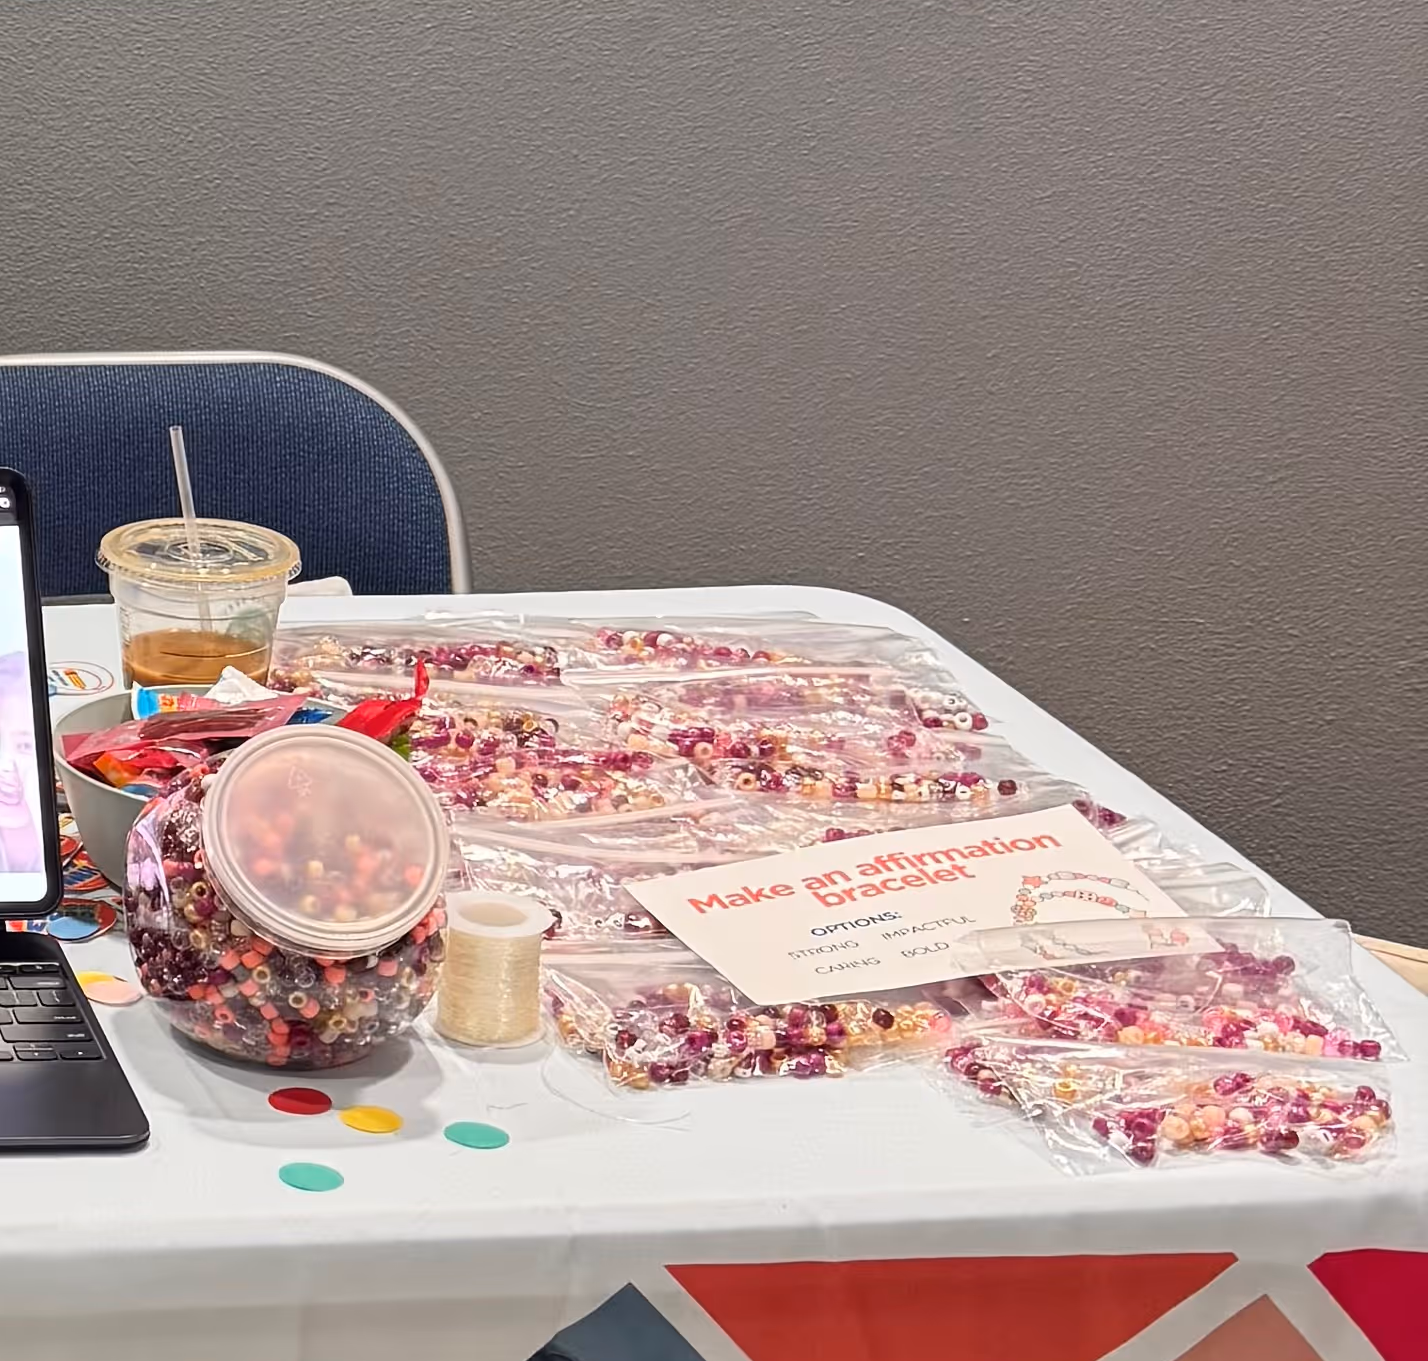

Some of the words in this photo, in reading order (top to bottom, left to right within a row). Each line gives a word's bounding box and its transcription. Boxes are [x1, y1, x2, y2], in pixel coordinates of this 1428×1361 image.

[687, 882, 795, 914] Make
[802, 869, 851, 892] an
[856, 834, 1062, 878] affirmation
[811, 862, 976, 908] bracelet
[788, 940, 859, 960] STRONG
[881, 915, 976, 940] IMPACTFUL
[810, 911, 902, 937] OPTIONS:
[815, 957, 882, 974] CARING
[900, 941, 949, 958] BOLD
